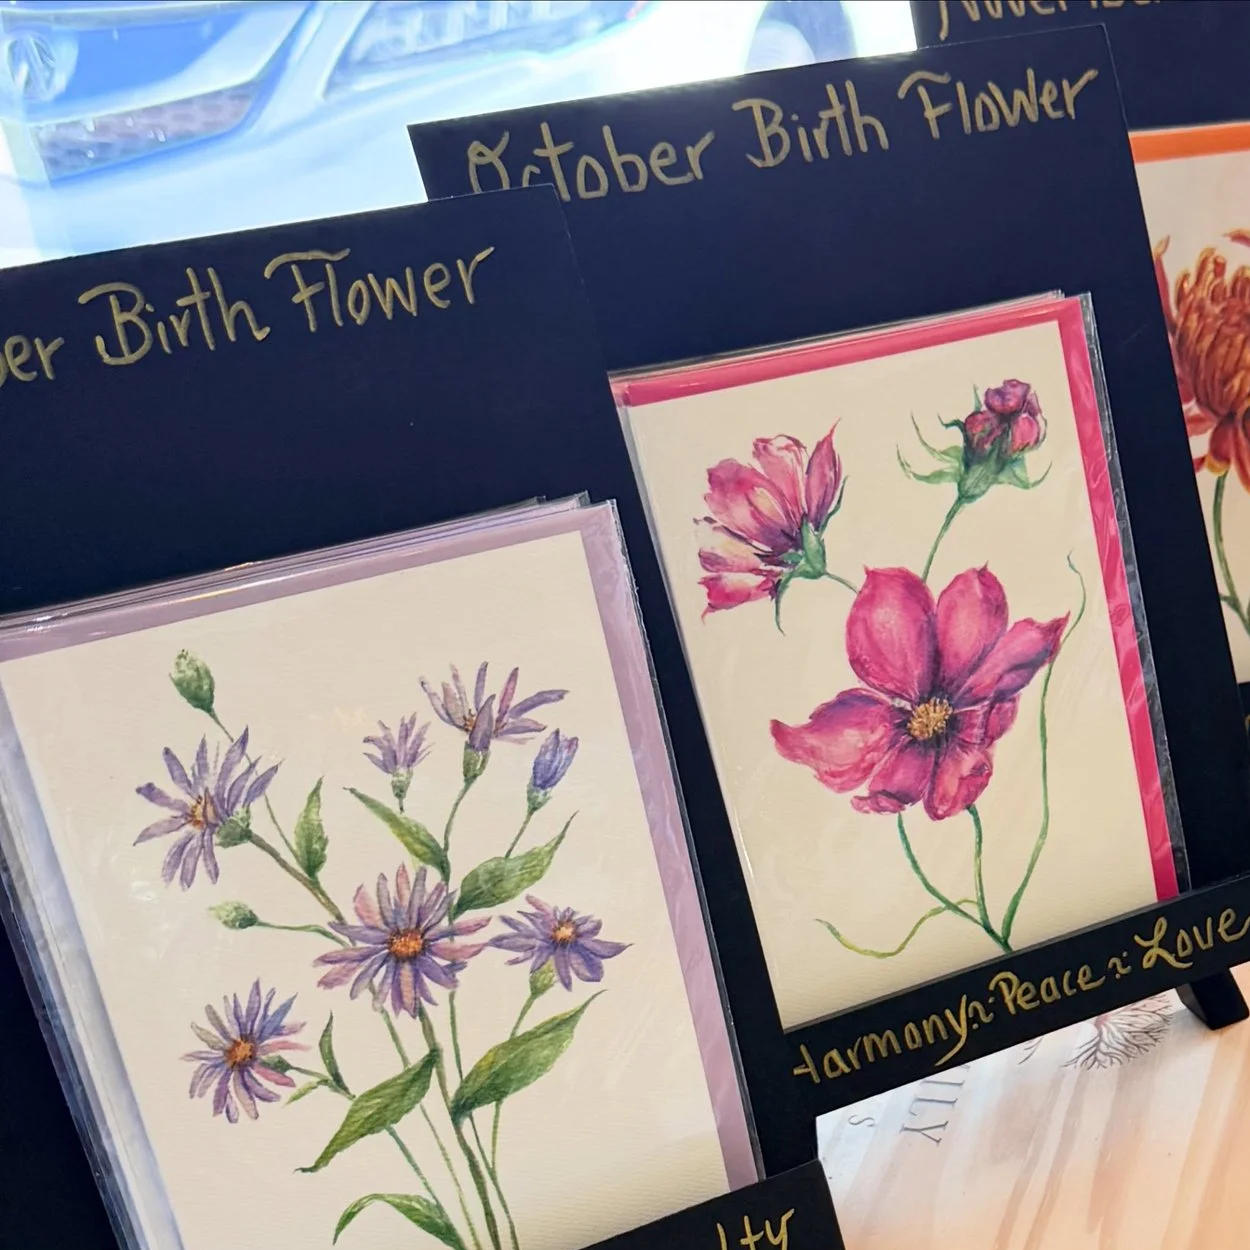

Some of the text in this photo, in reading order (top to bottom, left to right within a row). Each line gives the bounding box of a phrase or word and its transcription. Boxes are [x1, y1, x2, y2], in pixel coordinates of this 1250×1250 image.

[732, 80, 889, 168] Birth
[898, 68, 1098, 139] Flower
[78, 267, 270, 365] Birth
[264, 246, 495, 332] Flower
[989, 959, 1106, 1016] Peace
